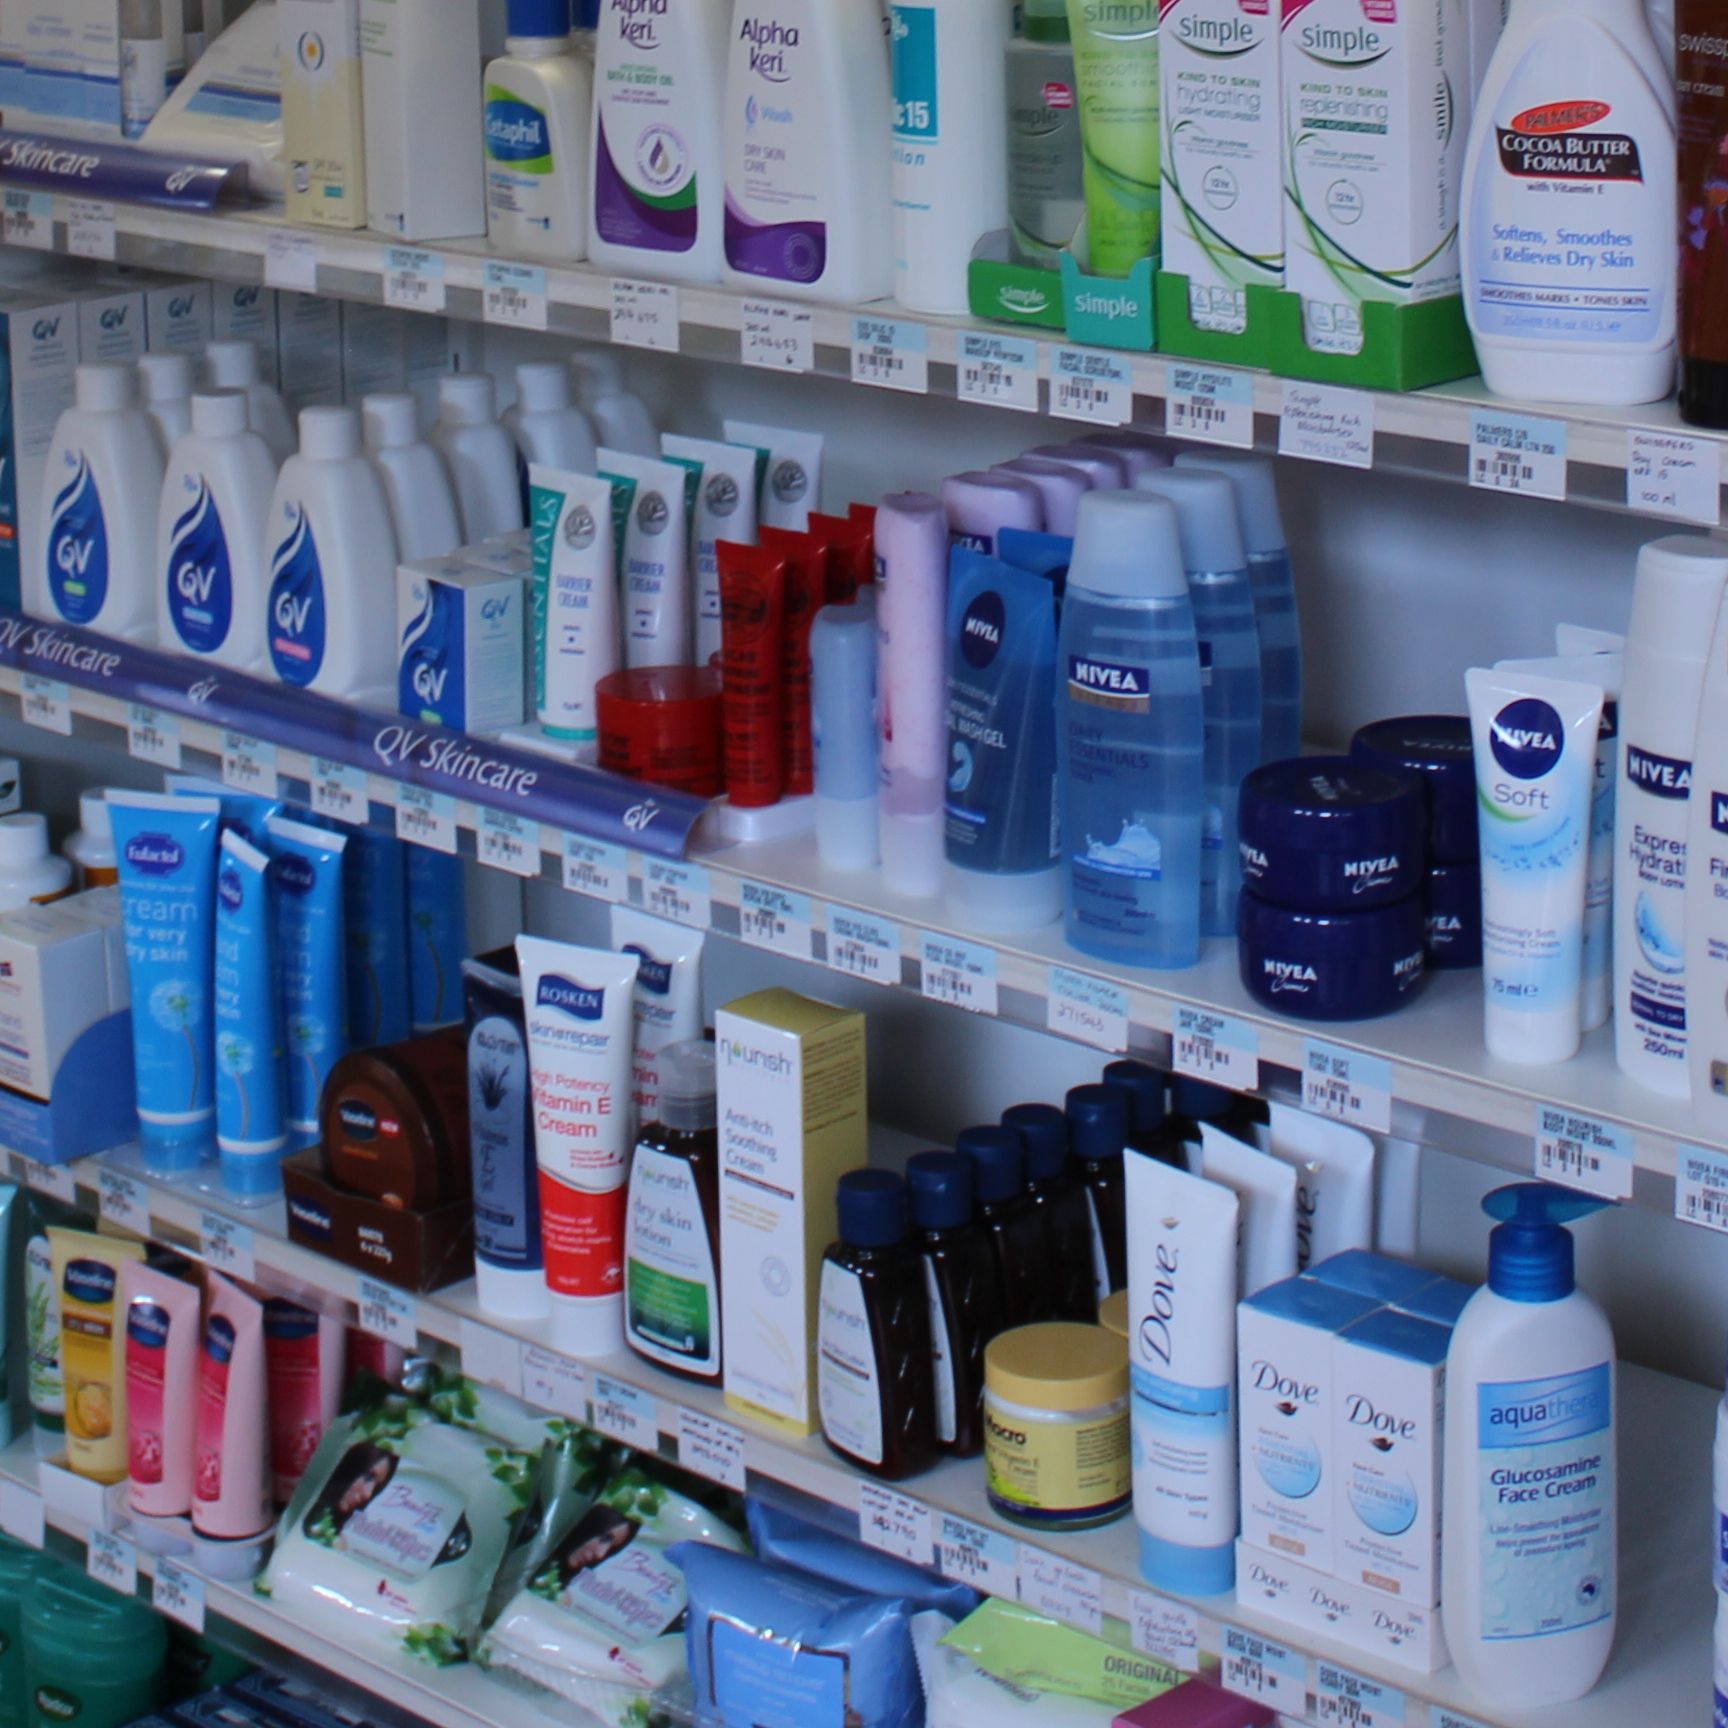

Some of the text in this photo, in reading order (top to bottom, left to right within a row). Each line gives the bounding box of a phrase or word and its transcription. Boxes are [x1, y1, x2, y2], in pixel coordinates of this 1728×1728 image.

[739, 17, 800, 49] Alpha
[1179, 15, 1254, 47] simple
[1301, 23, 1380, 57] simple
[1176, 83, 1262, 113] hydrating
[1299, 96, 1389, 124] replenishing
[486, 113, 542, 146] Cetaphil
[1501, 133, 1631, 157] COCOA BUTTER
[3, 138, 101, 181] Skincare
[1523, 153, 1608, 174] FORMULA
[1492, 223, 1634, 248] Softens, Smoothes
[1502, 246, 1635, 272] Relieves Dry Skin
[1074, 290, 1139, 319] simple
[55, 532, 94, 575] QV
[176, 561, 217, 604] QV
[274, 592, 312, 637] QV
[965, 618, 1000, 645] NIVEA
[24, 622, 123, 678] Skincare
[411, 662, 446, 702] QV
[1075, 661, 1140, 692] NIVEA
[373, 725, 539, 799] QV Skincare
[1628, 752, 1692, 790] NIVEA
[1493, 782, 1551, 811] Soft
[1343, 854, 1400, 879] NIVEA
[1264, 960, 1319, 984] NIVEA
[539, 985, 600, 1009] ROSKEN
[555, 1073, 612, 1096] Potency
[598, 1096, 613, 1116] E
[537, 1111, 599, 1139] Cream
[725, 1150, 766, 1174] Cream
[633, 1195, 695, 1232] dry skin
[1138, 1241, 1182, 1366] Dove
[1251, 1359, 1320, 1405] Dove
[1345, 1393, 1417, 1440] Dove
[1489, 1392, 1600, 1430] aquathera
[1490, 1454, 1602, 1487] Glucosamine
[1498, 1474, 1598, 1505] Face Cream
[1249, 1563, 1290, 1593] Dove
[1309, 1585, 1351, 1615] Dove
[1372, 1608, 1416, 1639] Dove
